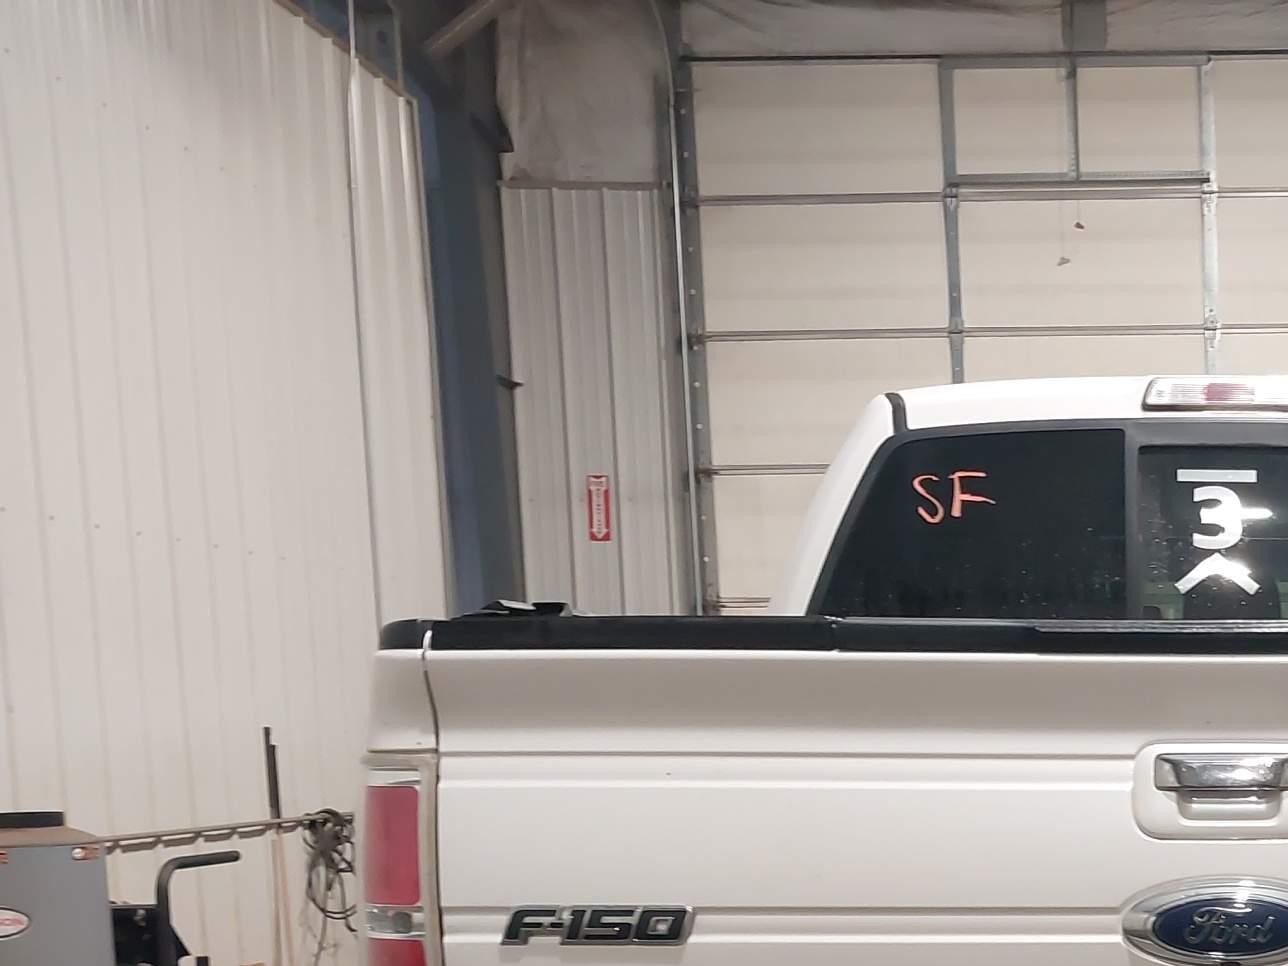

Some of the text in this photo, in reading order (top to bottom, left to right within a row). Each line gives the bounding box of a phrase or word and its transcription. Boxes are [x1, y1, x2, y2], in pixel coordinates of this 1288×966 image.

[912, 471, 996, 523] SF
[500, 904, 696, 945] F-150
[1184, 906, 1275, 944] Ford
